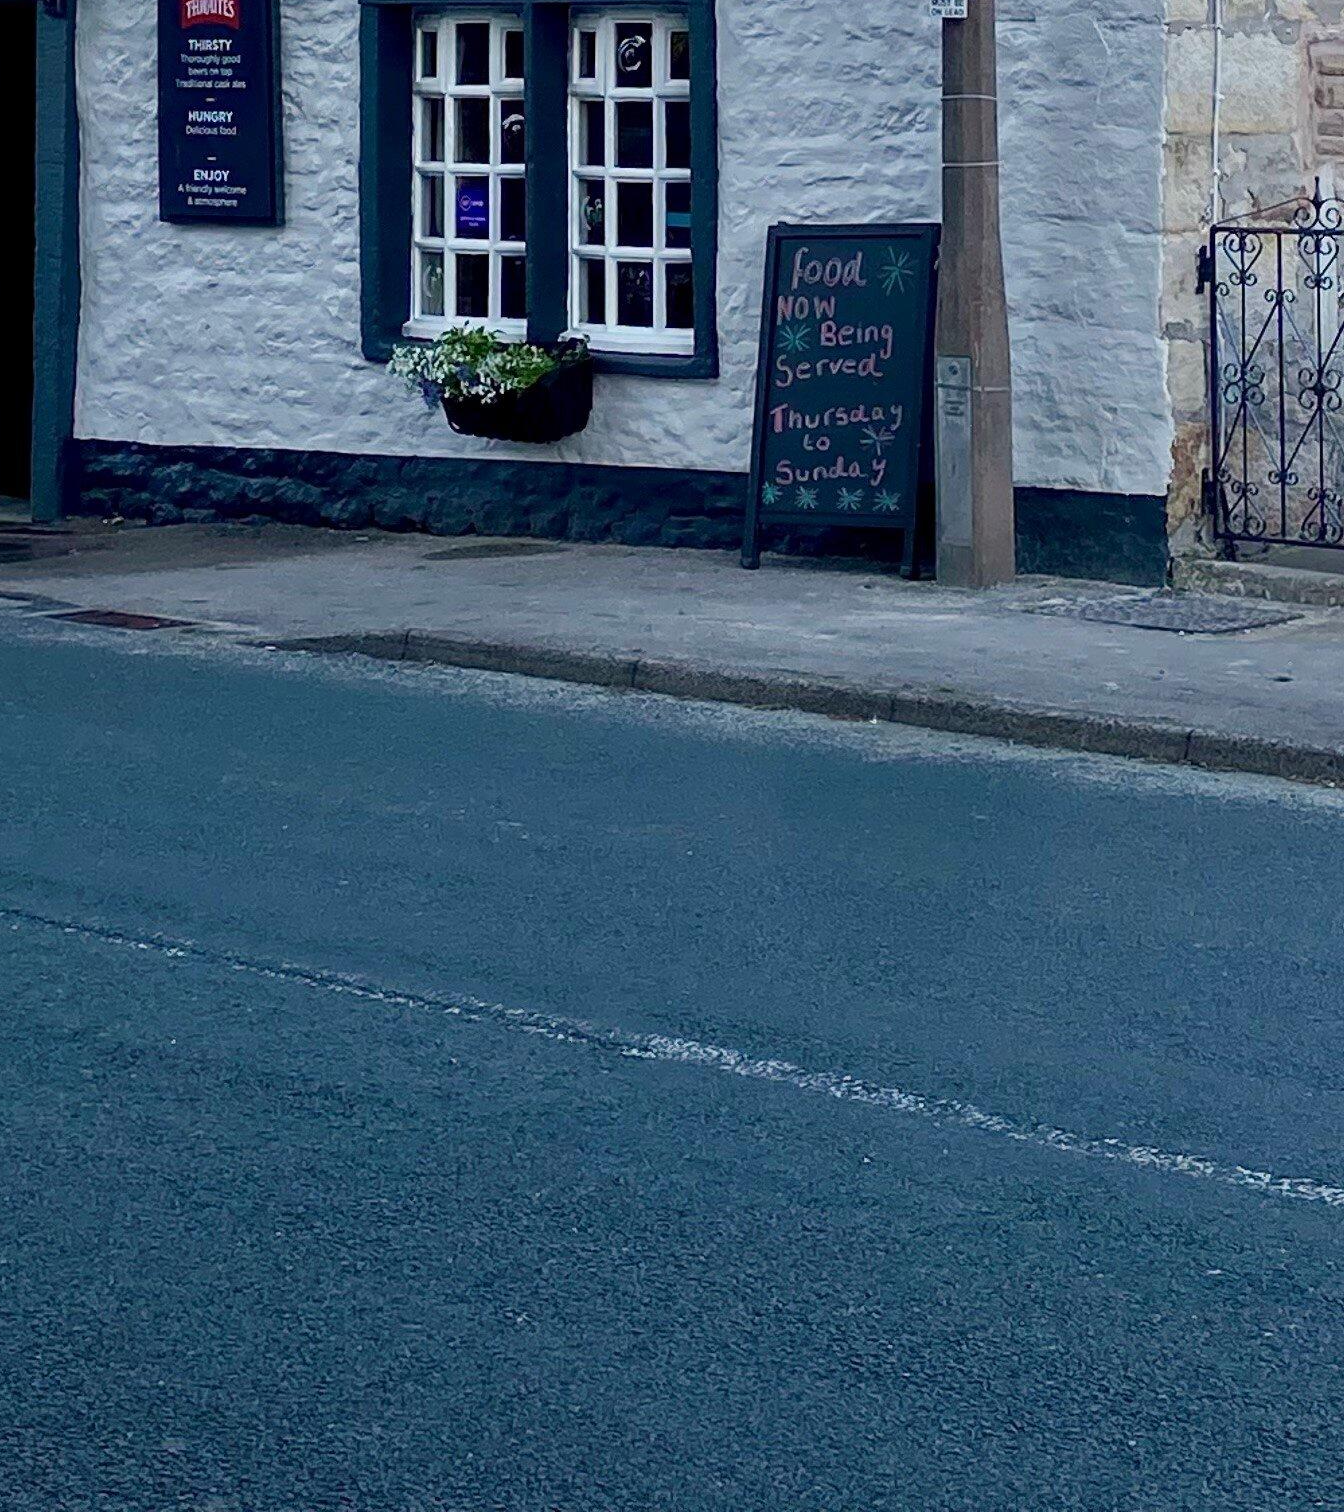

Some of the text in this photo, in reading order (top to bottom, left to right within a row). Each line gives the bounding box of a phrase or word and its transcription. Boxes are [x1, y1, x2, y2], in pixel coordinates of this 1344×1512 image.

[188, 39, 232, 51] THIRSTY
[180, 53, 241, 65] Thoroughly good
[188, 110, 233, 122] HUNGRY
[185, 125, 236, 135] Delicious food
[193, 169, 230, 181] ENJOY
[177, 183, 184, 193] A
[185, 183, 213, 195] friendly
[820, 320, 894, 360] Being
[775, 353, 884, 388] Served
[769, 402, 903, 433] Thursday
[803, 433, 831, 451] to
[775, 454, 887, 487] Sunday
